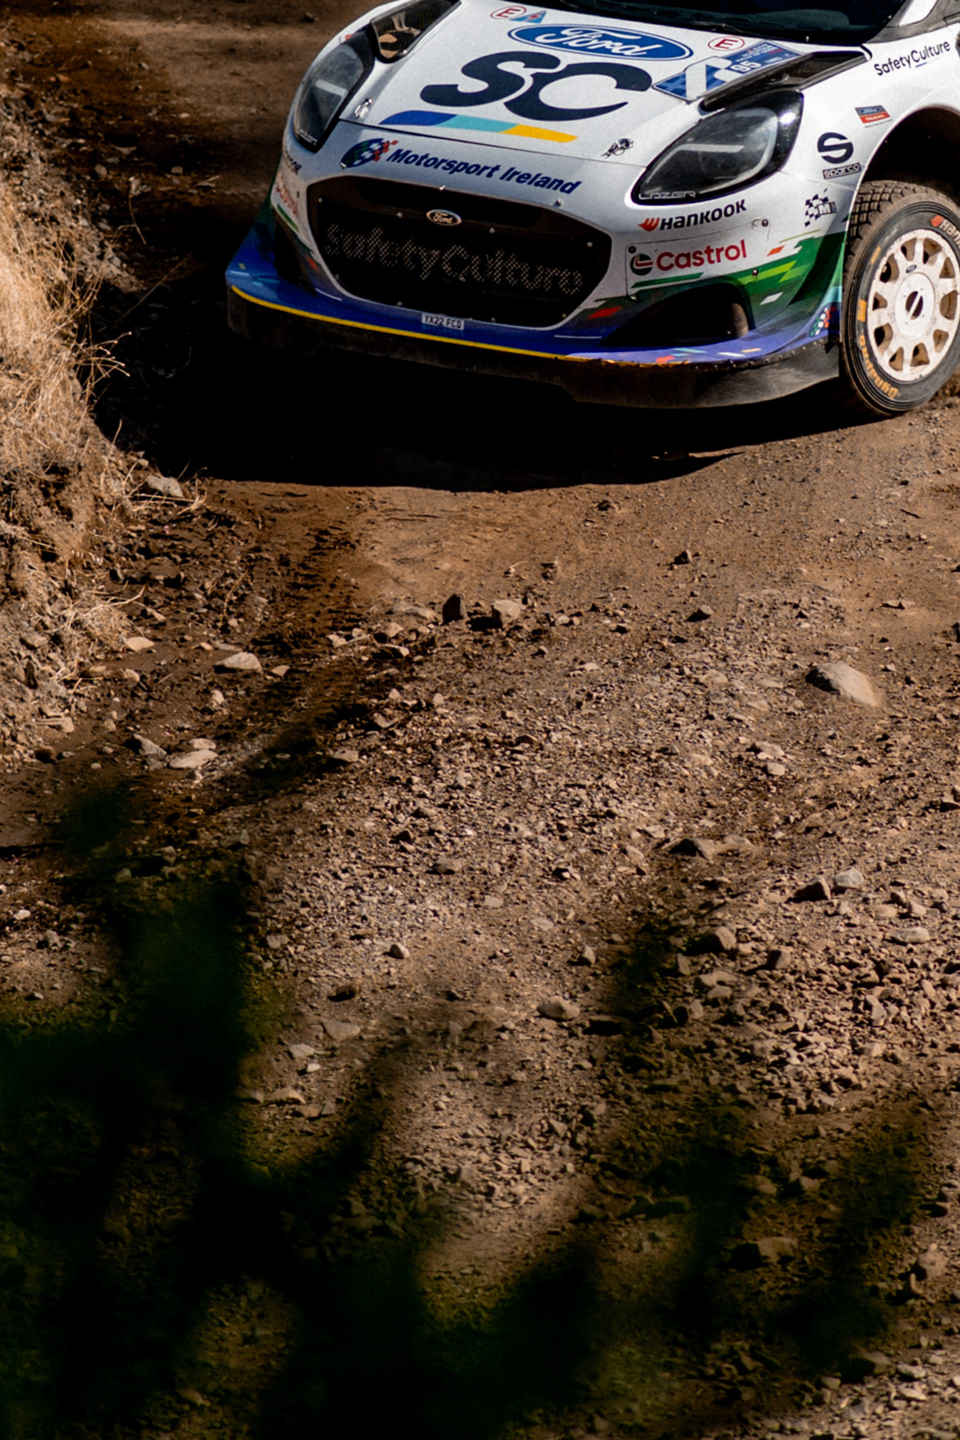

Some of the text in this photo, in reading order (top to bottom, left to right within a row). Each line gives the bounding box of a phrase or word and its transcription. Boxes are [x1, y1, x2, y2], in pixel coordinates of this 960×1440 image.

[496, 7, 521, 18] E
[534, 27, 662, 56] Ford
[714, 38, 738, 50] E
[730, 60, 761, 72] 95
[874, 41, 950, 76] SafetyCulture
[420, 51, 652, 121] SC
[386, 148, 583, 195] Motorsport Ireland
[825, 164, 861, 178] sparco
[432, 212, 454, 224] Ford
[325, 223, 583, 295] SafetyCulture
[656, 240, 747, 271] Castrol
[424, 314, 444, 326] YX22
